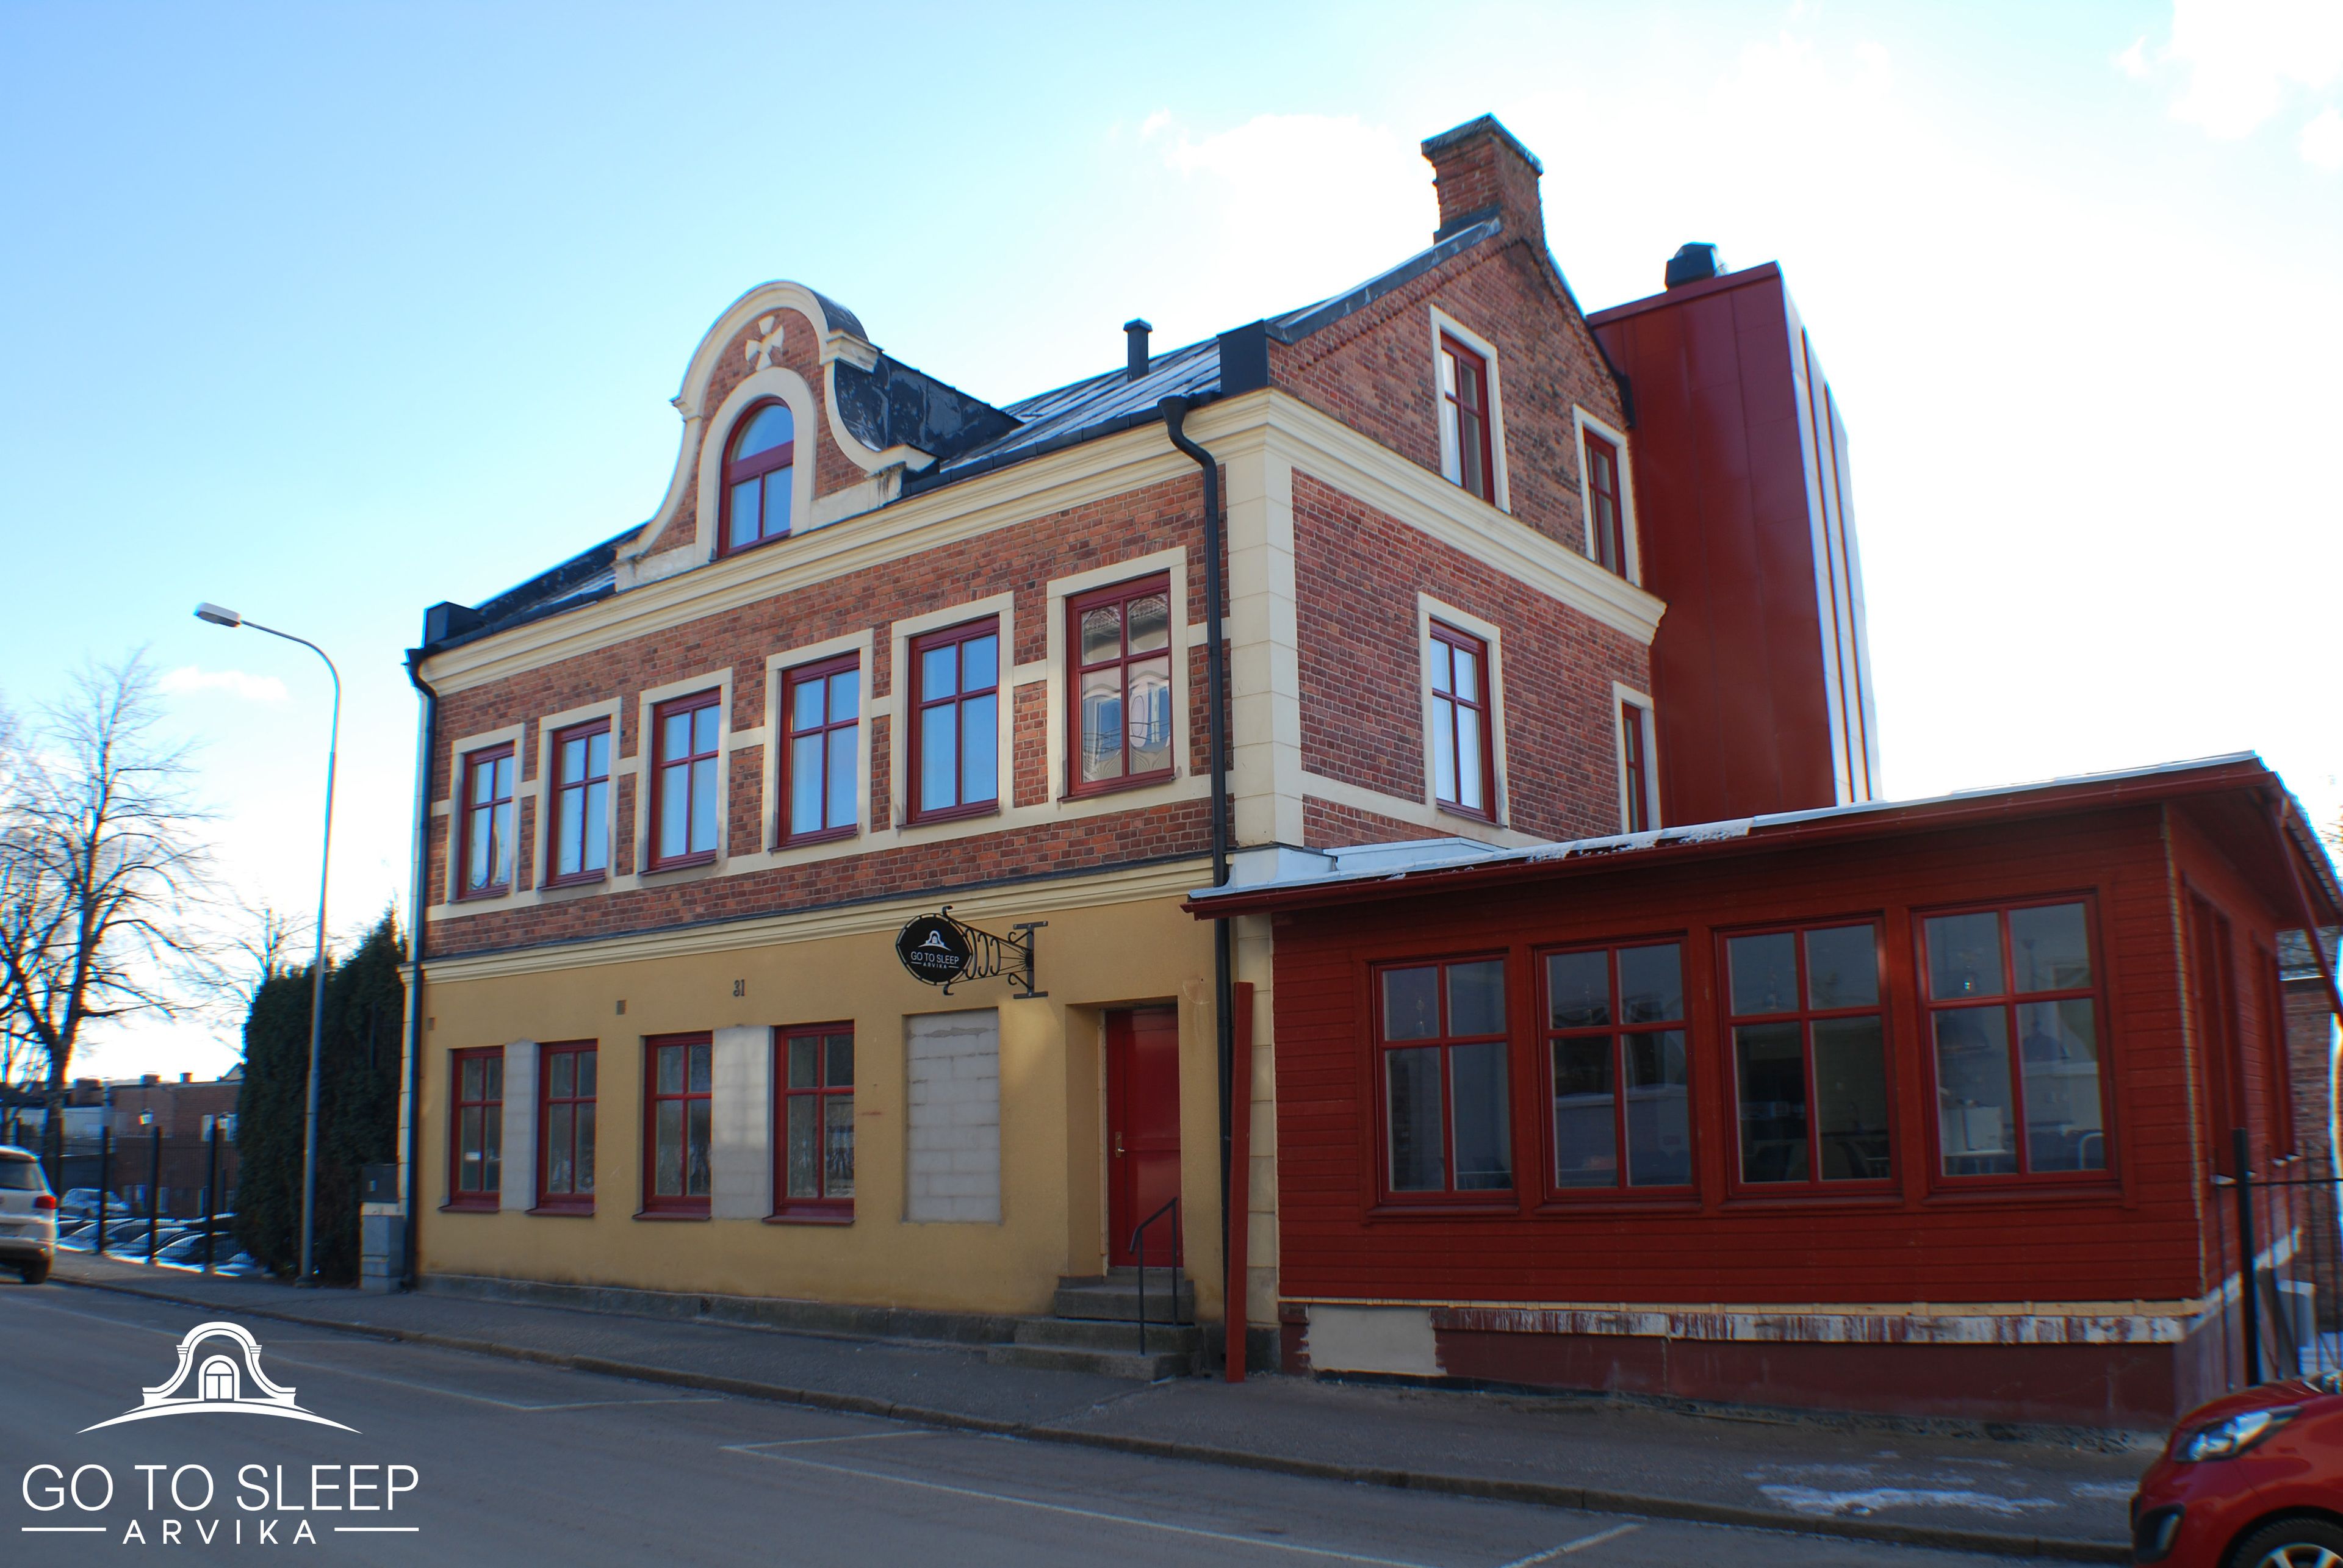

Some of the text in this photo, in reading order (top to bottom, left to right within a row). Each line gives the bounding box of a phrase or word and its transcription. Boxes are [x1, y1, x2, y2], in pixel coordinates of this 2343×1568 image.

[910, 951, 959, 965] GO TO SLEEP
[733, 979, 745, 997] 31
